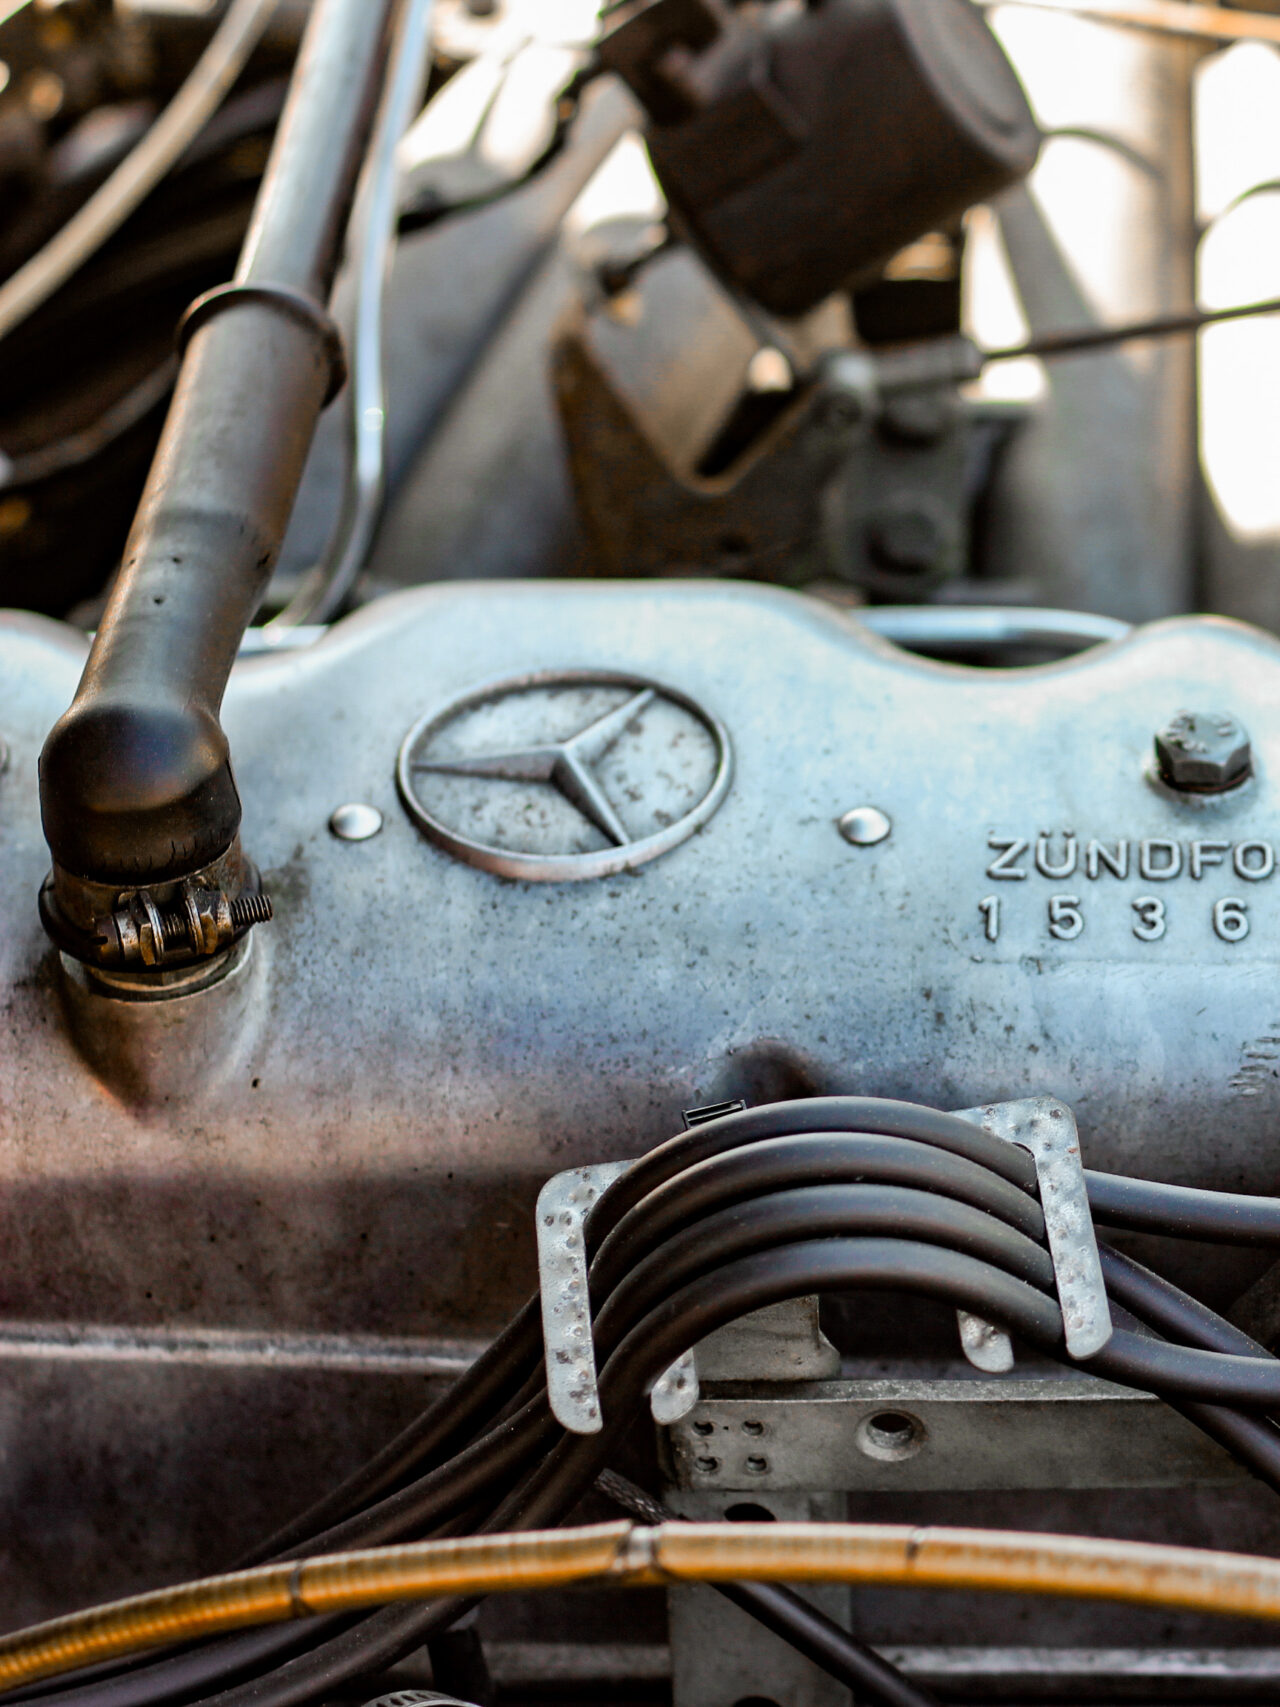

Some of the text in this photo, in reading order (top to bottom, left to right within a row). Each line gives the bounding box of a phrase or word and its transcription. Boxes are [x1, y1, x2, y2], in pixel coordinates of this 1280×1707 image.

[978, 895, 1001, 942] 1
[1048, 895, 1084, 942] 5
[1131, 896, 1167, 943] 3
[1213, 897, 1251, 943] 6
